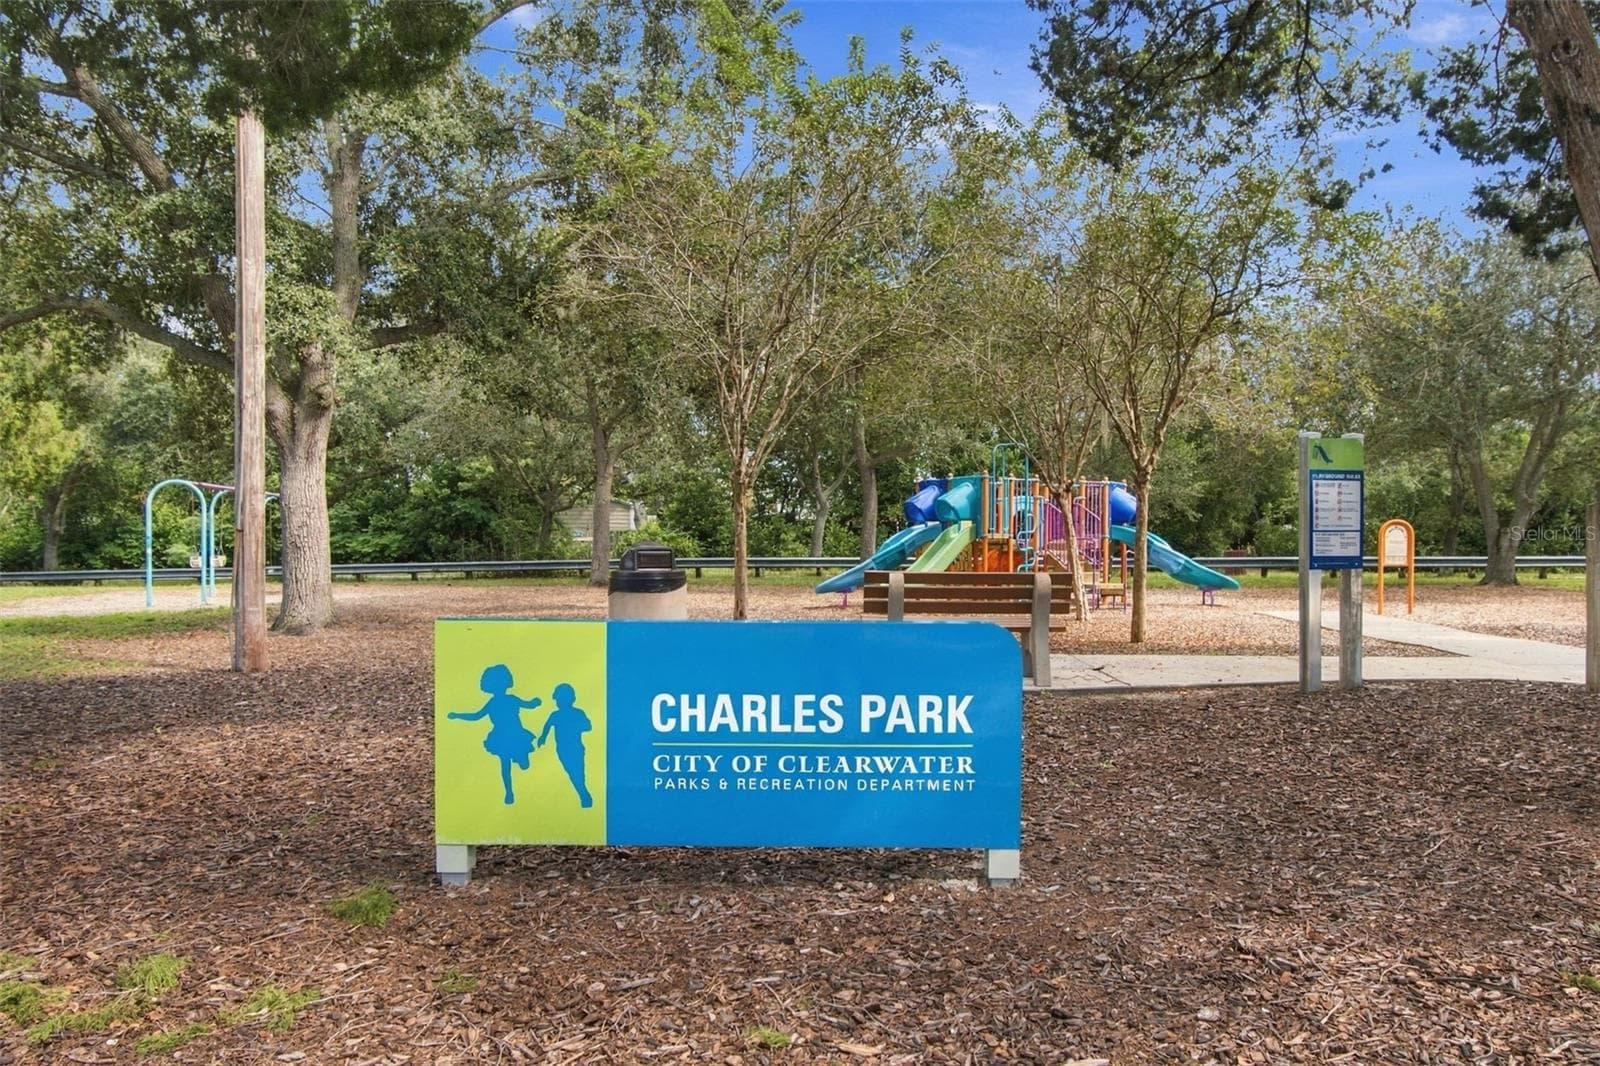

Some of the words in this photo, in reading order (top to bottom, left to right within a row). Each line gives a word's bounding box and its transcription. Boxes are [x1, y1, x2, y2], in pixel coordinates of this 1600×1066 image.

[651, 693, 844, 733] CHARLES
[860, 694, 974, 734] PARK
[652, 754, 723, 773] CITY
[731, 755, 768, 773] OF
[778, 755, 976, 774] CLEARWATER
[654, 778, 710, 790] PARKS
[719, 778, 728, 790] &
[737, 778, 848, 791] RECREATION
[857, 778, 976, 791] DEPARTMENT
